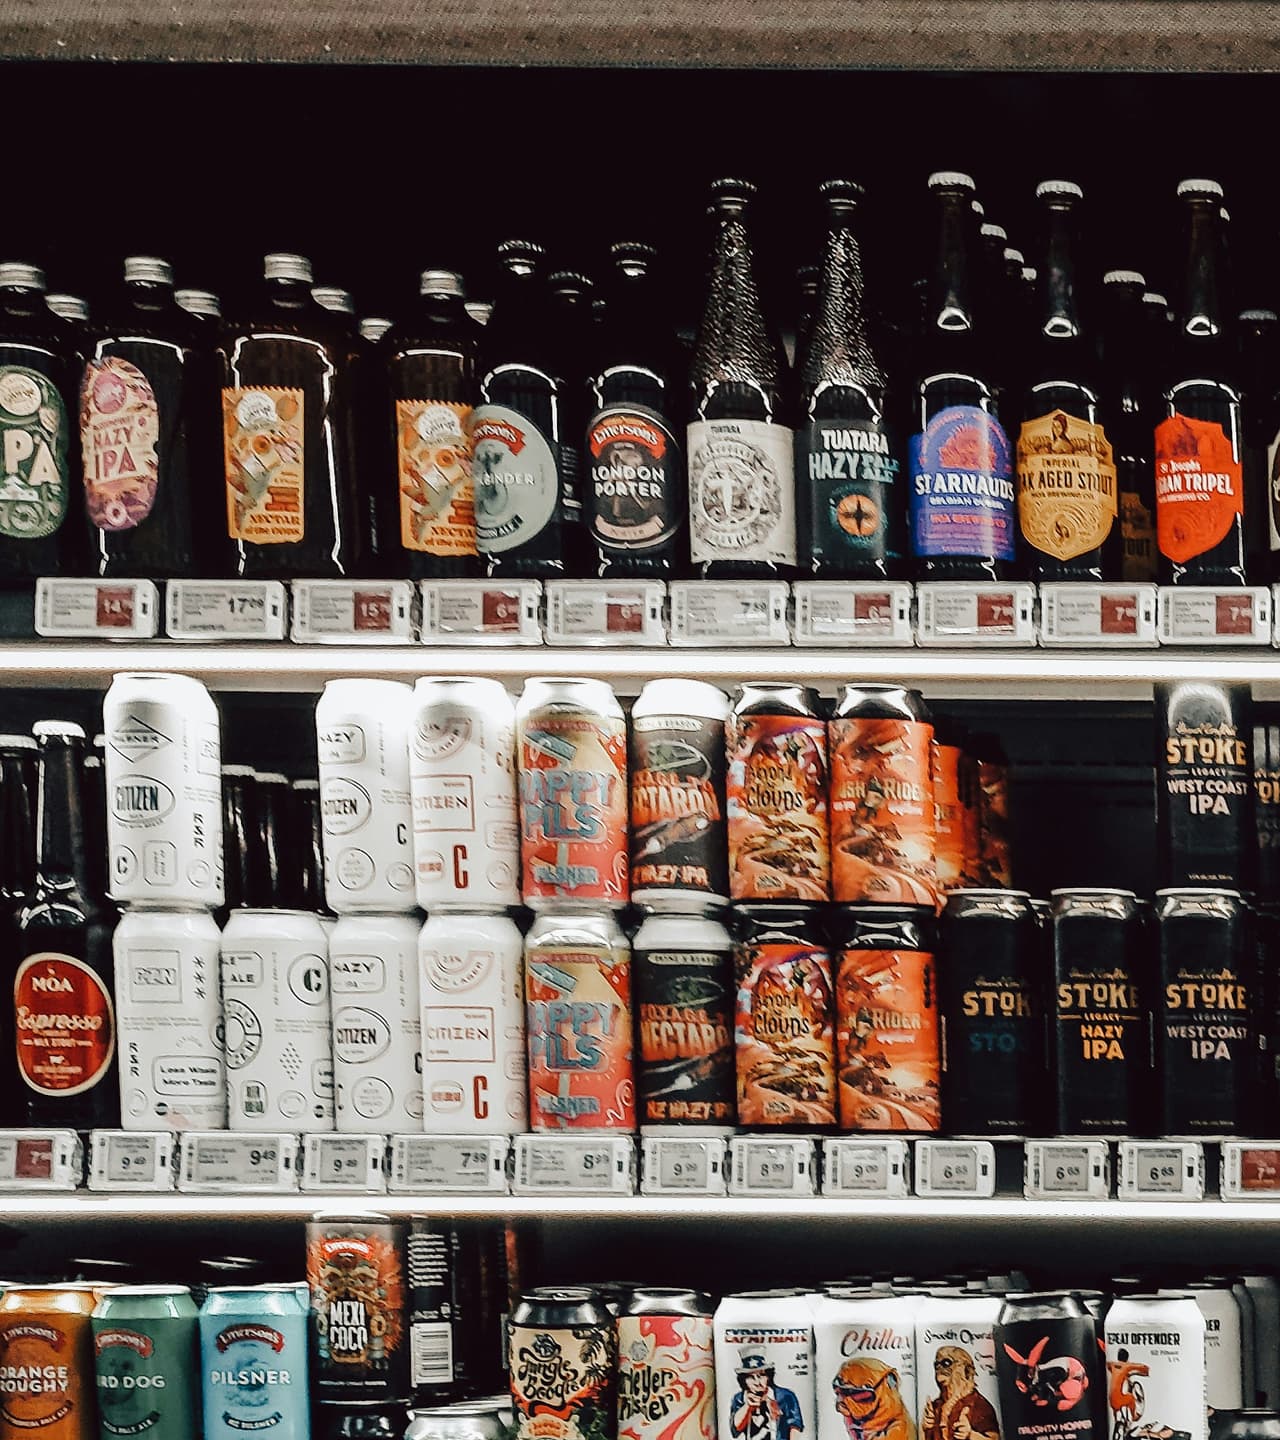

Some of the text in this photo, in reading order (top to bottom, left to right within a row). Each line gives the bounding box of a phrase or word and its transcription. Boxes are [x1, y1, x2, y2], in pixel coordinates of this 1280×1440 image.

[822, 430, 888, 454] TUATARA
[594, 467, 667, 484] LONDON
[810, 454, 859, 481] HAZY
[594, 481, 664, 501] PORTER
[1039, 474, 1079, 491] AGED
[1185, 474, 1234, 496] TRIPEL
[1167, 737, 1247, 765] STOKE
[1168, 779, 1247, 795] WEST COAST
[1190, 795, 1231, 816] IPA
[454, 844, 469, 890] C
[32, 977, 74, 995] MOA
[1058, 983, 1137, 1010] STOKE
[1081, 1025, 1125, 1040] HAZY
[1084, 1040, 1126, 1061] IPA
[330, 1302, 366, 1327] MEXI
[330, 1327, 368, 1351] COCO
[1131, 1333, 1180, 1347] OFFENDER
[211, 1370, 291, 1385] PILSNER
